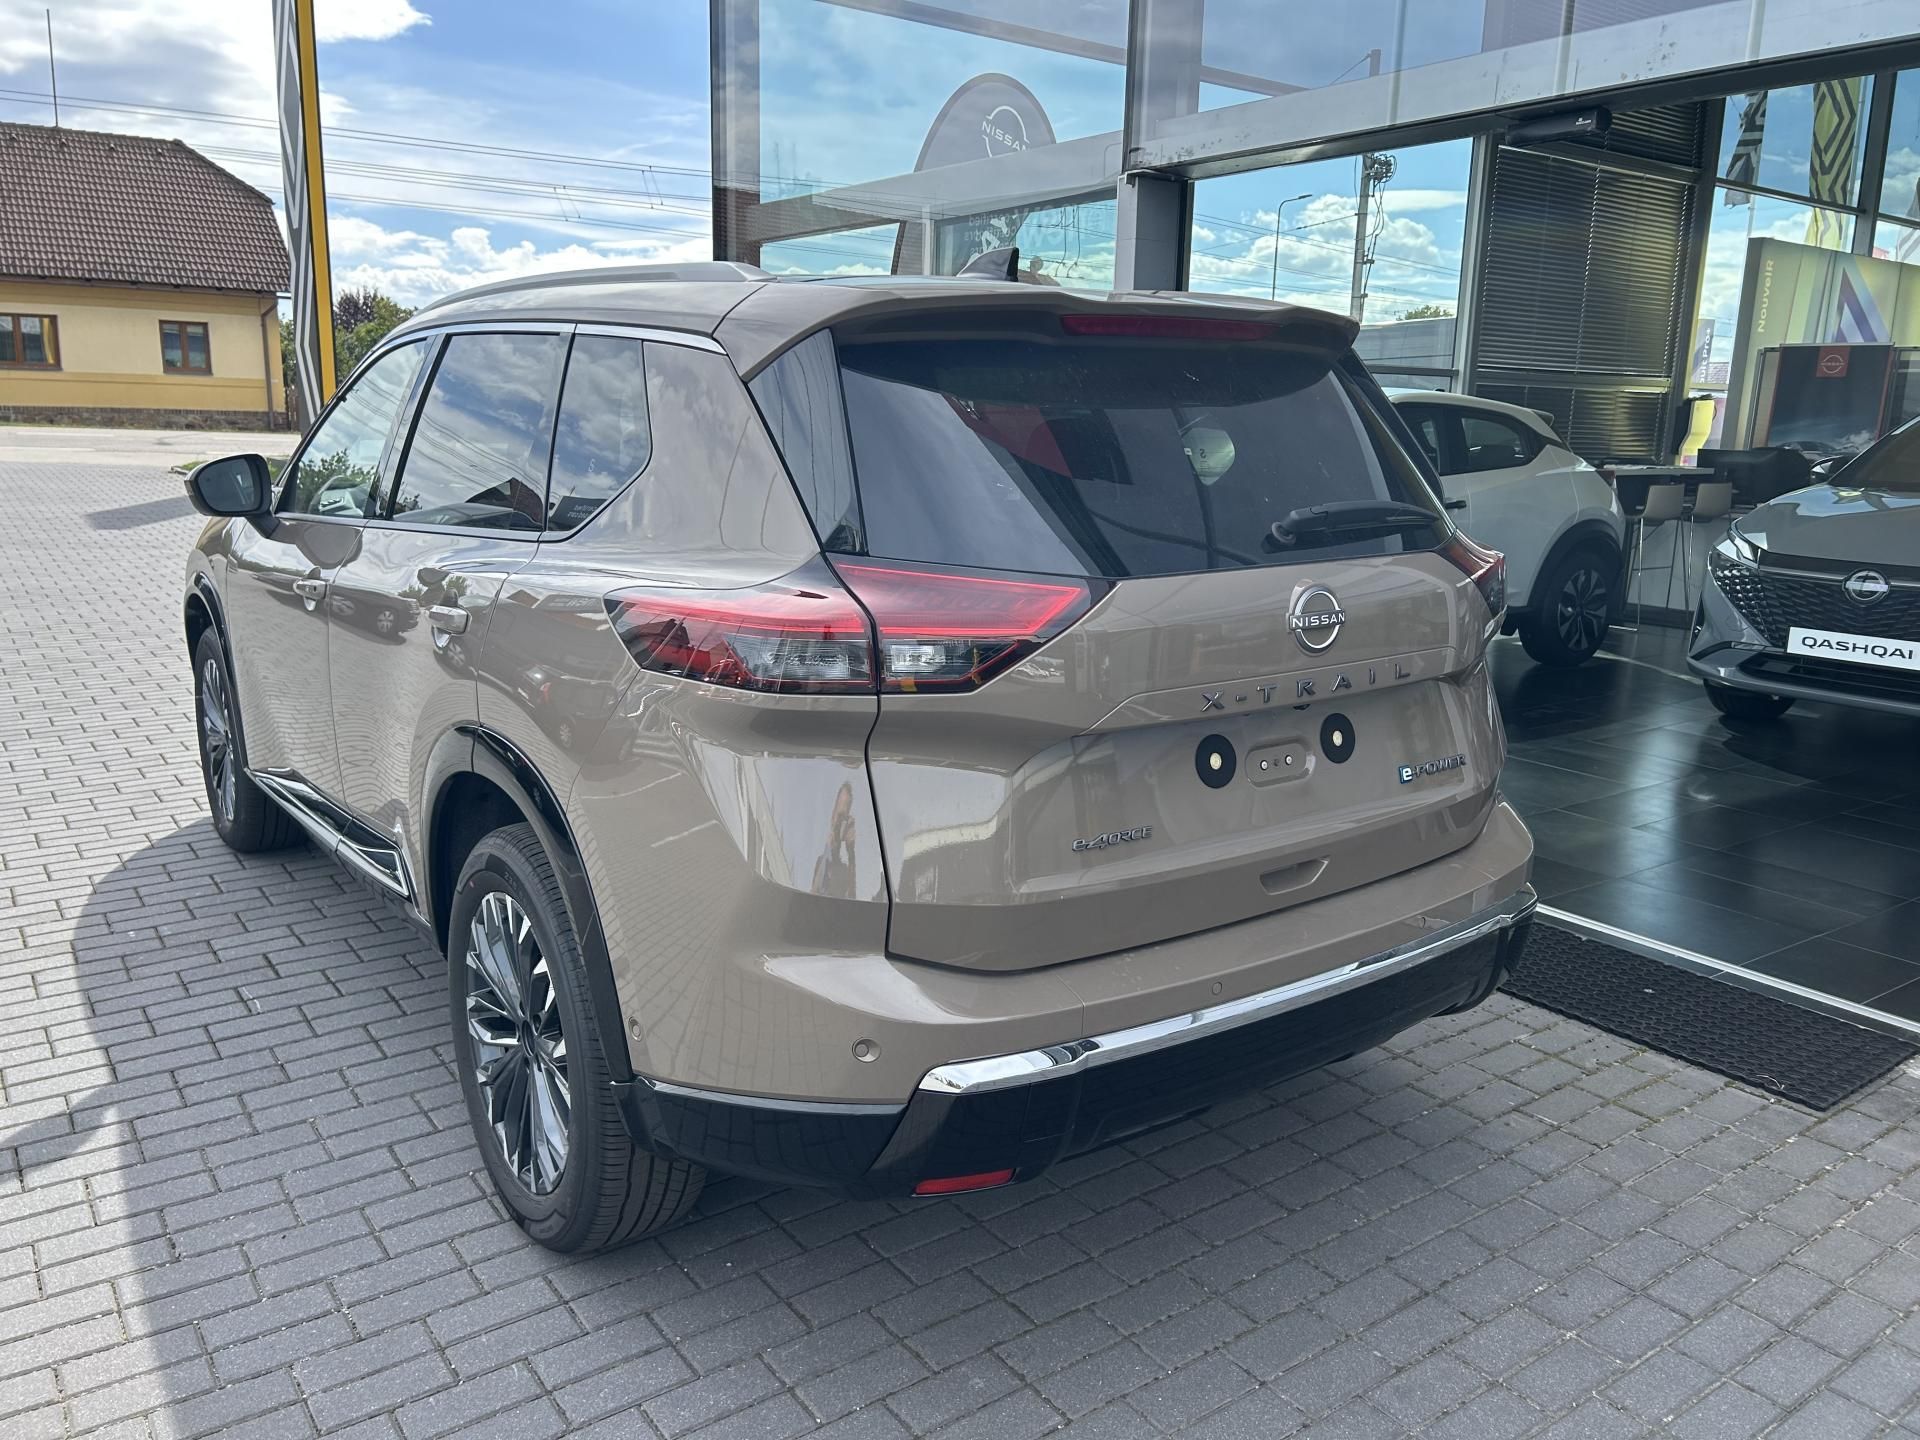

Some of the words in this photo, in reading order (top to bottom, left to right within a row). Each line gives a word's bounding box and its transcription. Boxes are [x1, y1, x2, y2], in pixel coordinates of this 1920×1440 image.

[1291, 611, 1345, 628] NISSAN
[1801, 636, 1913, 659] QASHQAI
[1200, 663, 1411, 713] X-TRAIL
